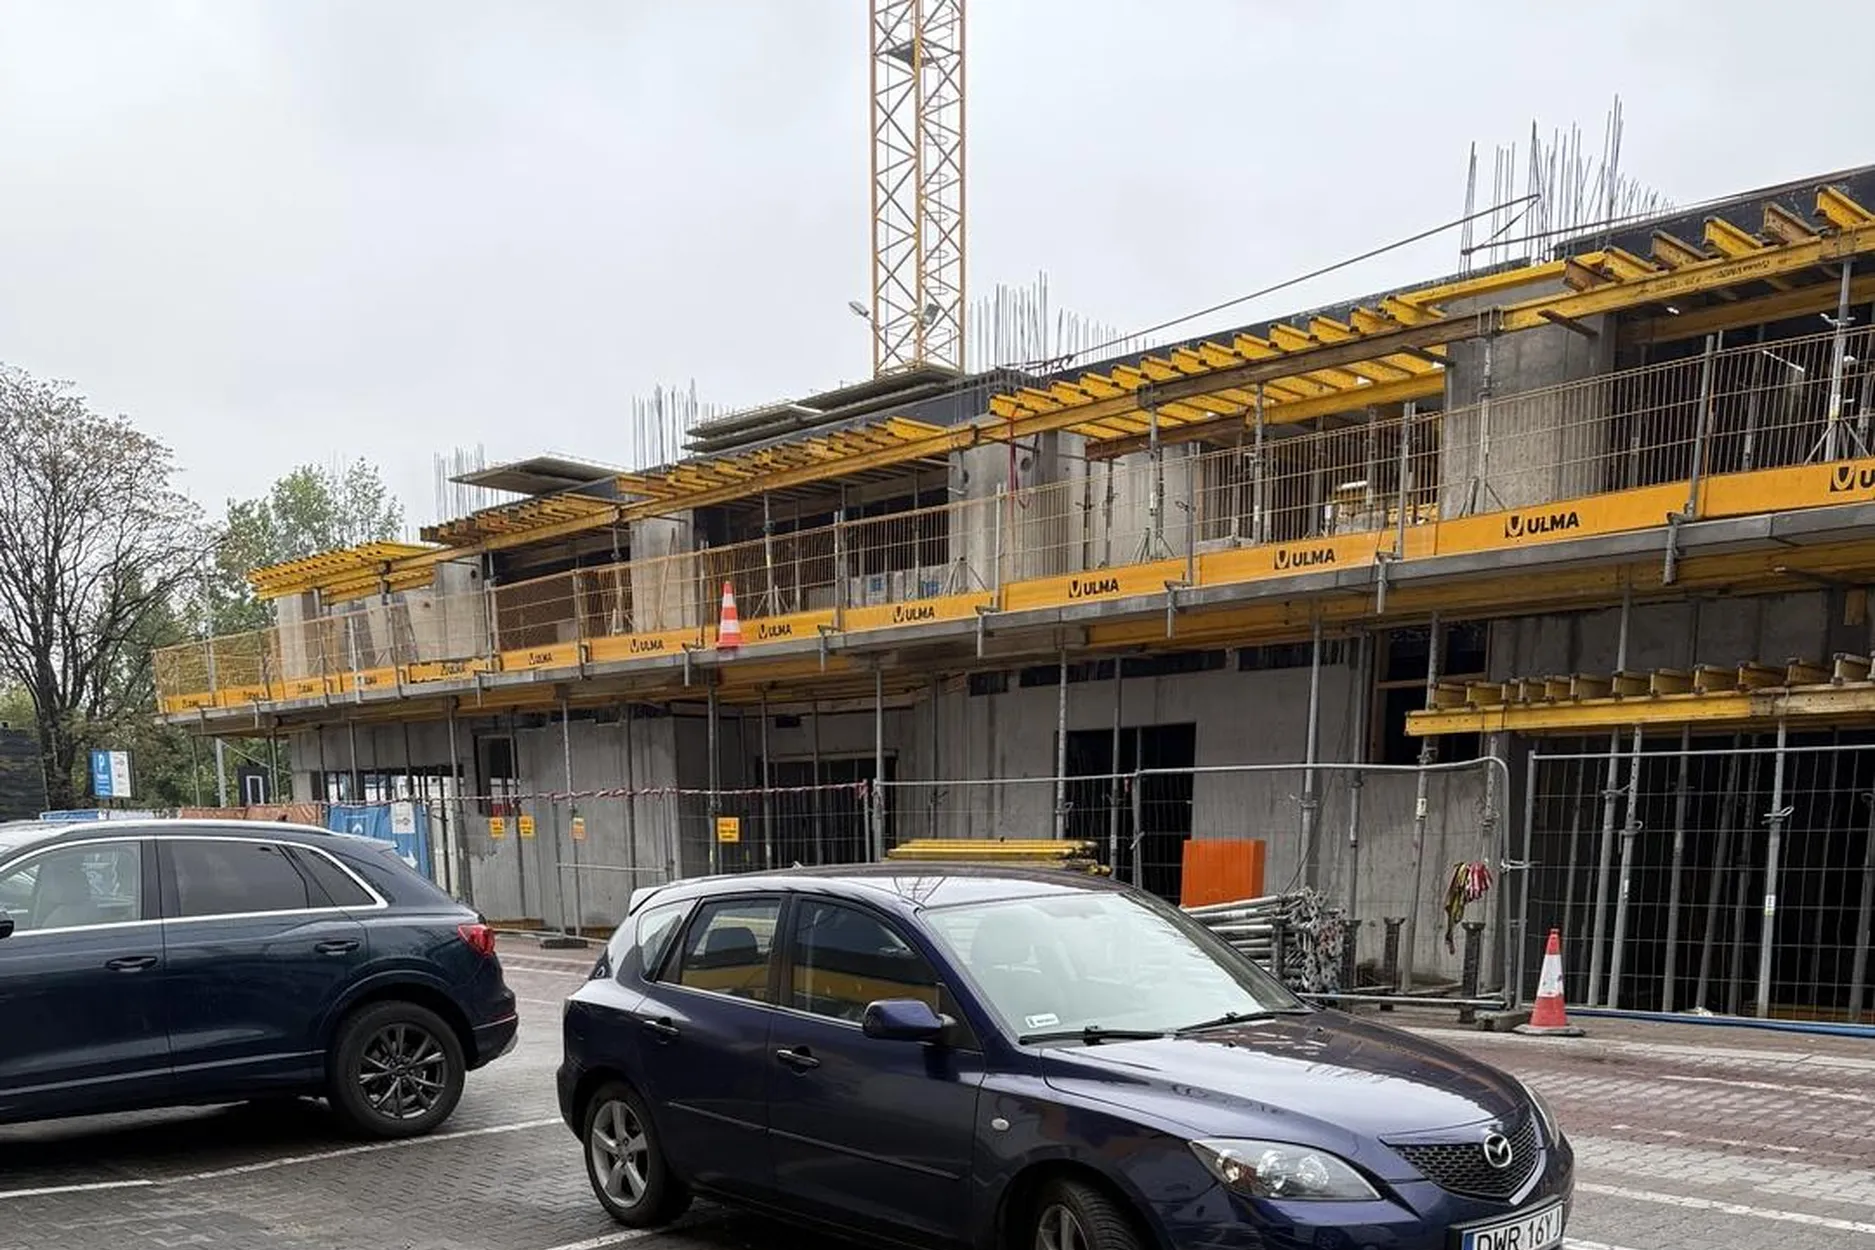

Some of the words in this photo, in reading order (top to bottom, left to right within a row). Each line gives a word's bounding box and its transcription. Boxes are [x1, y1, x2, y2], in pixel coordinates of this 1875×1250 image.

[1527, 512, 1579, 534] ULMA
[1293, 548, 1336, 566] ULMA
[1083, 578, 1119, 595] ULMA
[905, 606, 935, 621] ULMA
[1528, 1208, 1560, 1249] 16YJ
